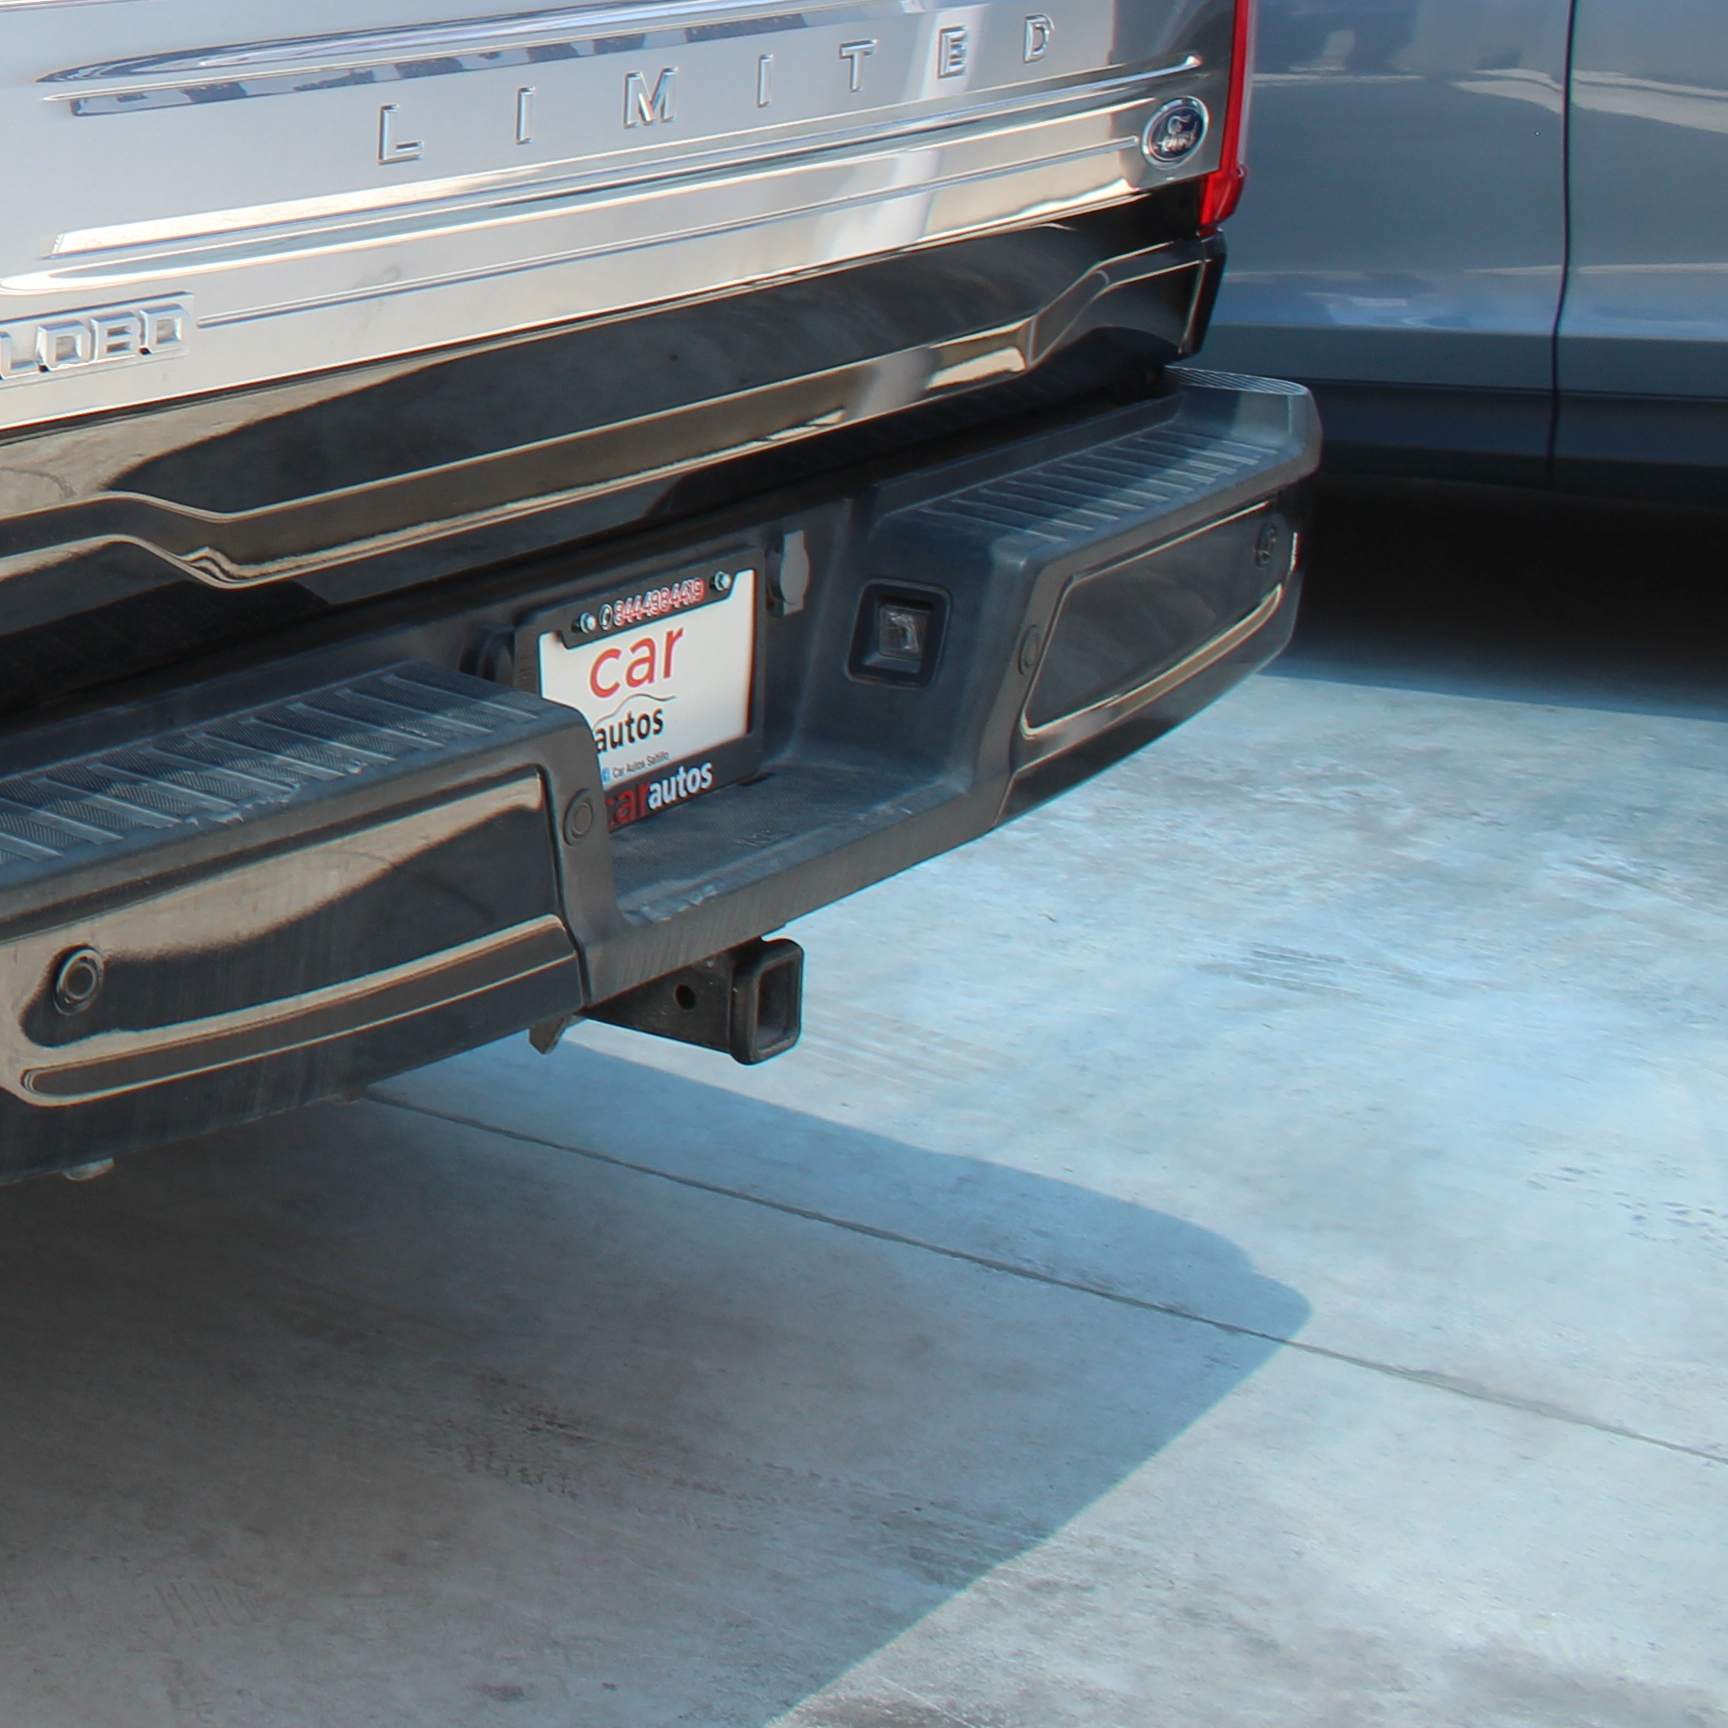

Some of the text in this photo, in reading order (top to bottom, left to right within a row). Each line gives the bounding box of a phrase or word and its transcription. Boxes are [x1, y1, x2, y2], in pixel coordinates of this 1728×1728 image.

[378, 14, 1056, 166] LIMITED
[589, 627, 684, 700] car
[594, 708, 664, 754] autos
